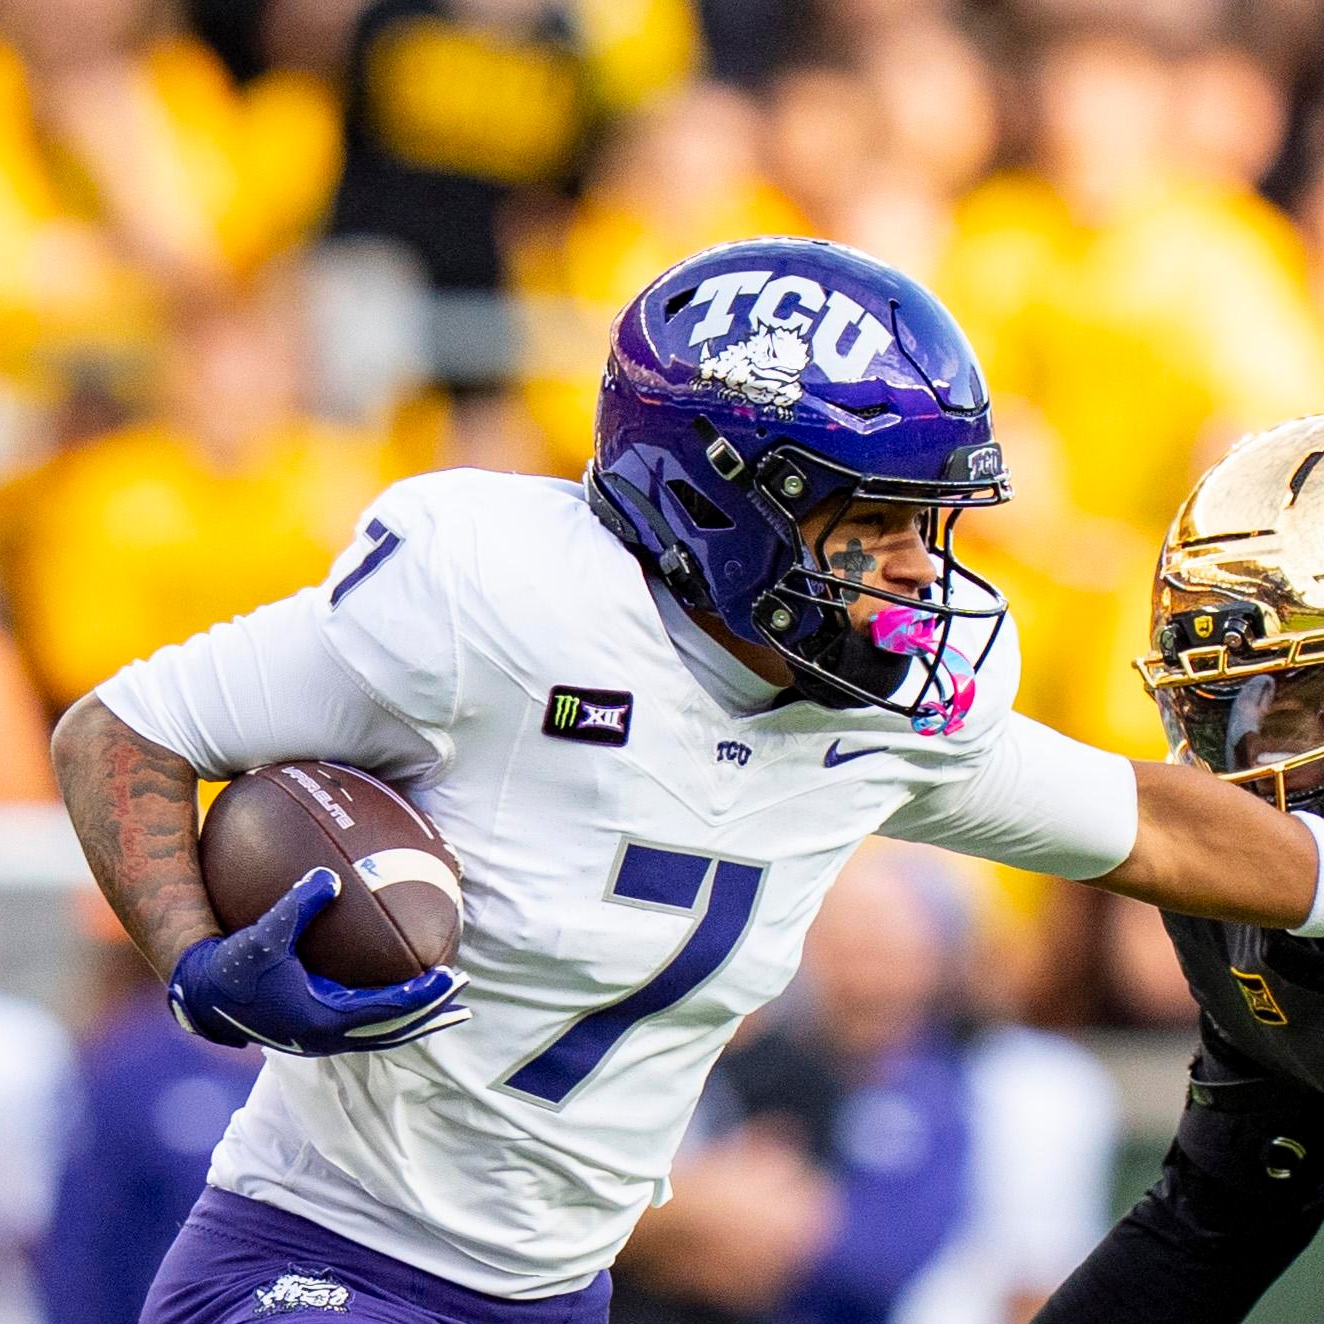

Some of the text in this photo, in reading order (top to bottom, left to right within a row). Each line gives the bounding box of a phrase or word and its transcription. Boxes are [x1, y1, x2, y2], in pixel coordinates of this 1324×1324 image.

[688, 270, 897, 384] TCU
[328, 514, 405, 612] 7
[715, 739, 753, 768] TCU
[312, 790, 356, 831] ELITE
[488, 834, 772, 1112] 7
